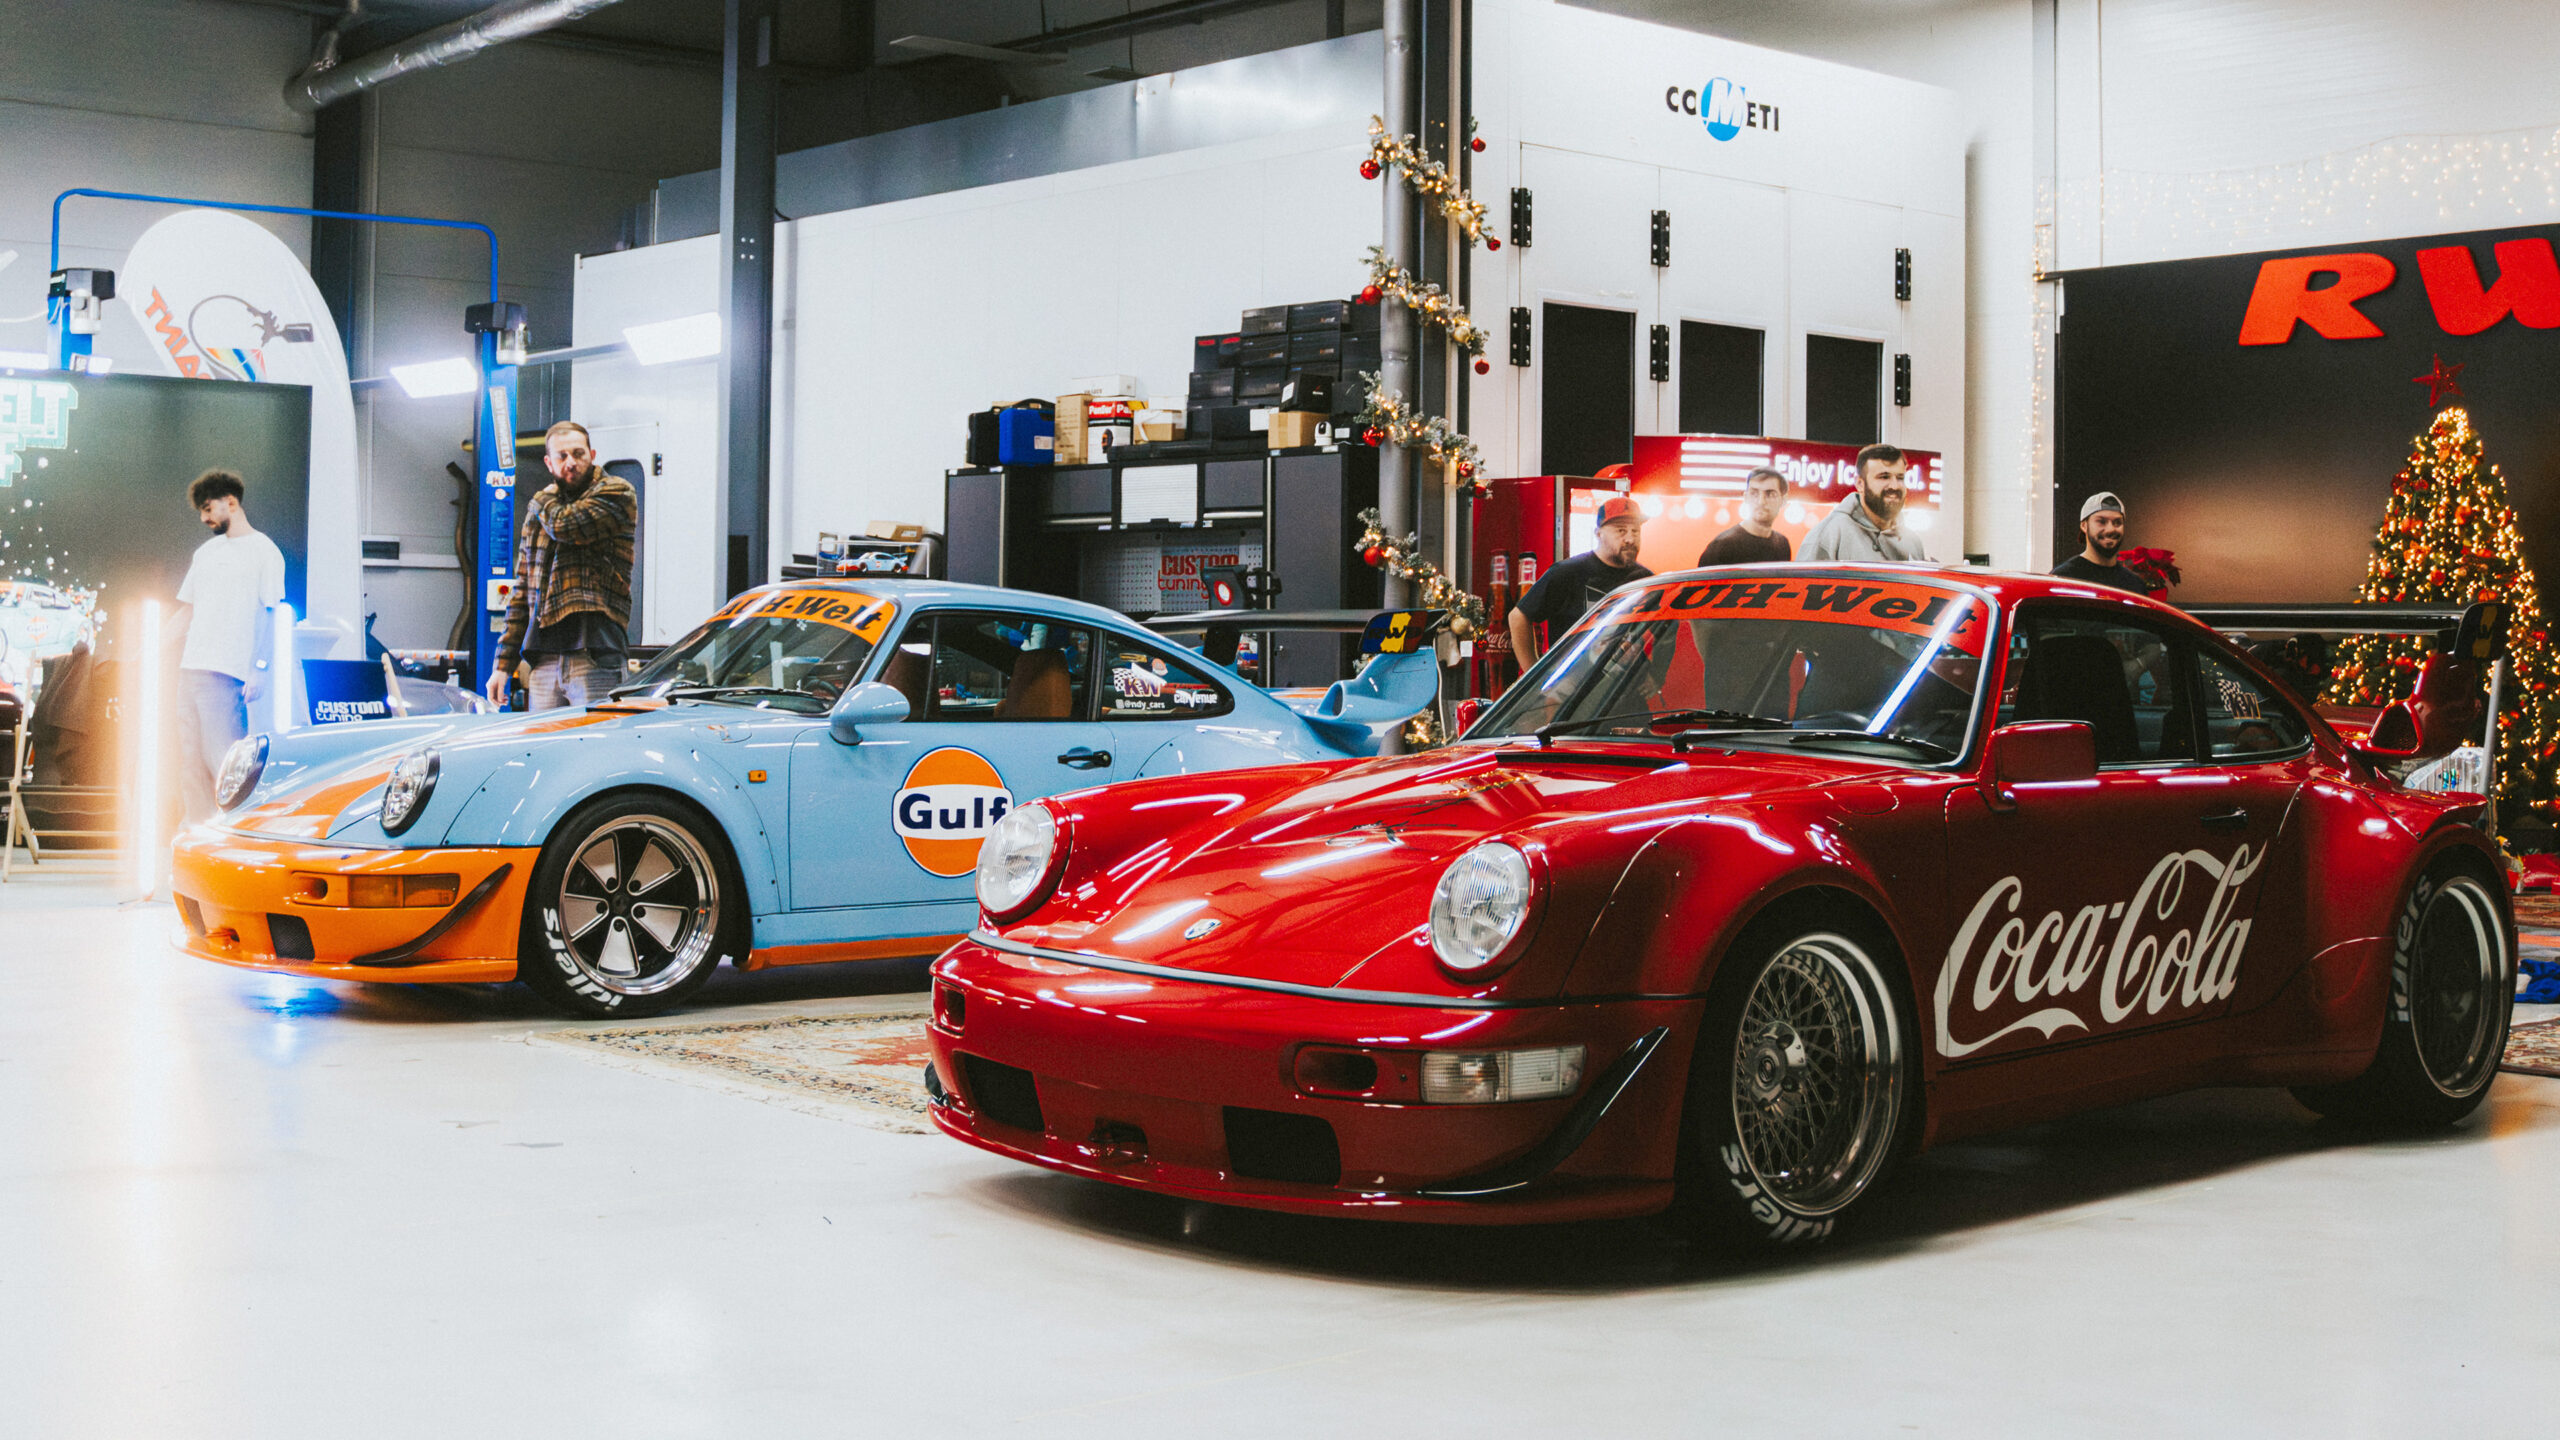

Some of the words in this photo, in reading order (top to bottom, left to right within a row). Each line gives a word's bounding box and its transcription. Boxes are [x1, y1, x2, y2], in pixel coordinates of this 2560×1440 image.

[1665, 78, 1780, 133] COMETI
[1774, 452, 1836, 490] Enjoy
[317, 700, 385, 715] CUSTOM
[899, 793, 1008, 830] Gulf
[1933, 840, 2268, 1058] Coca-Cola
